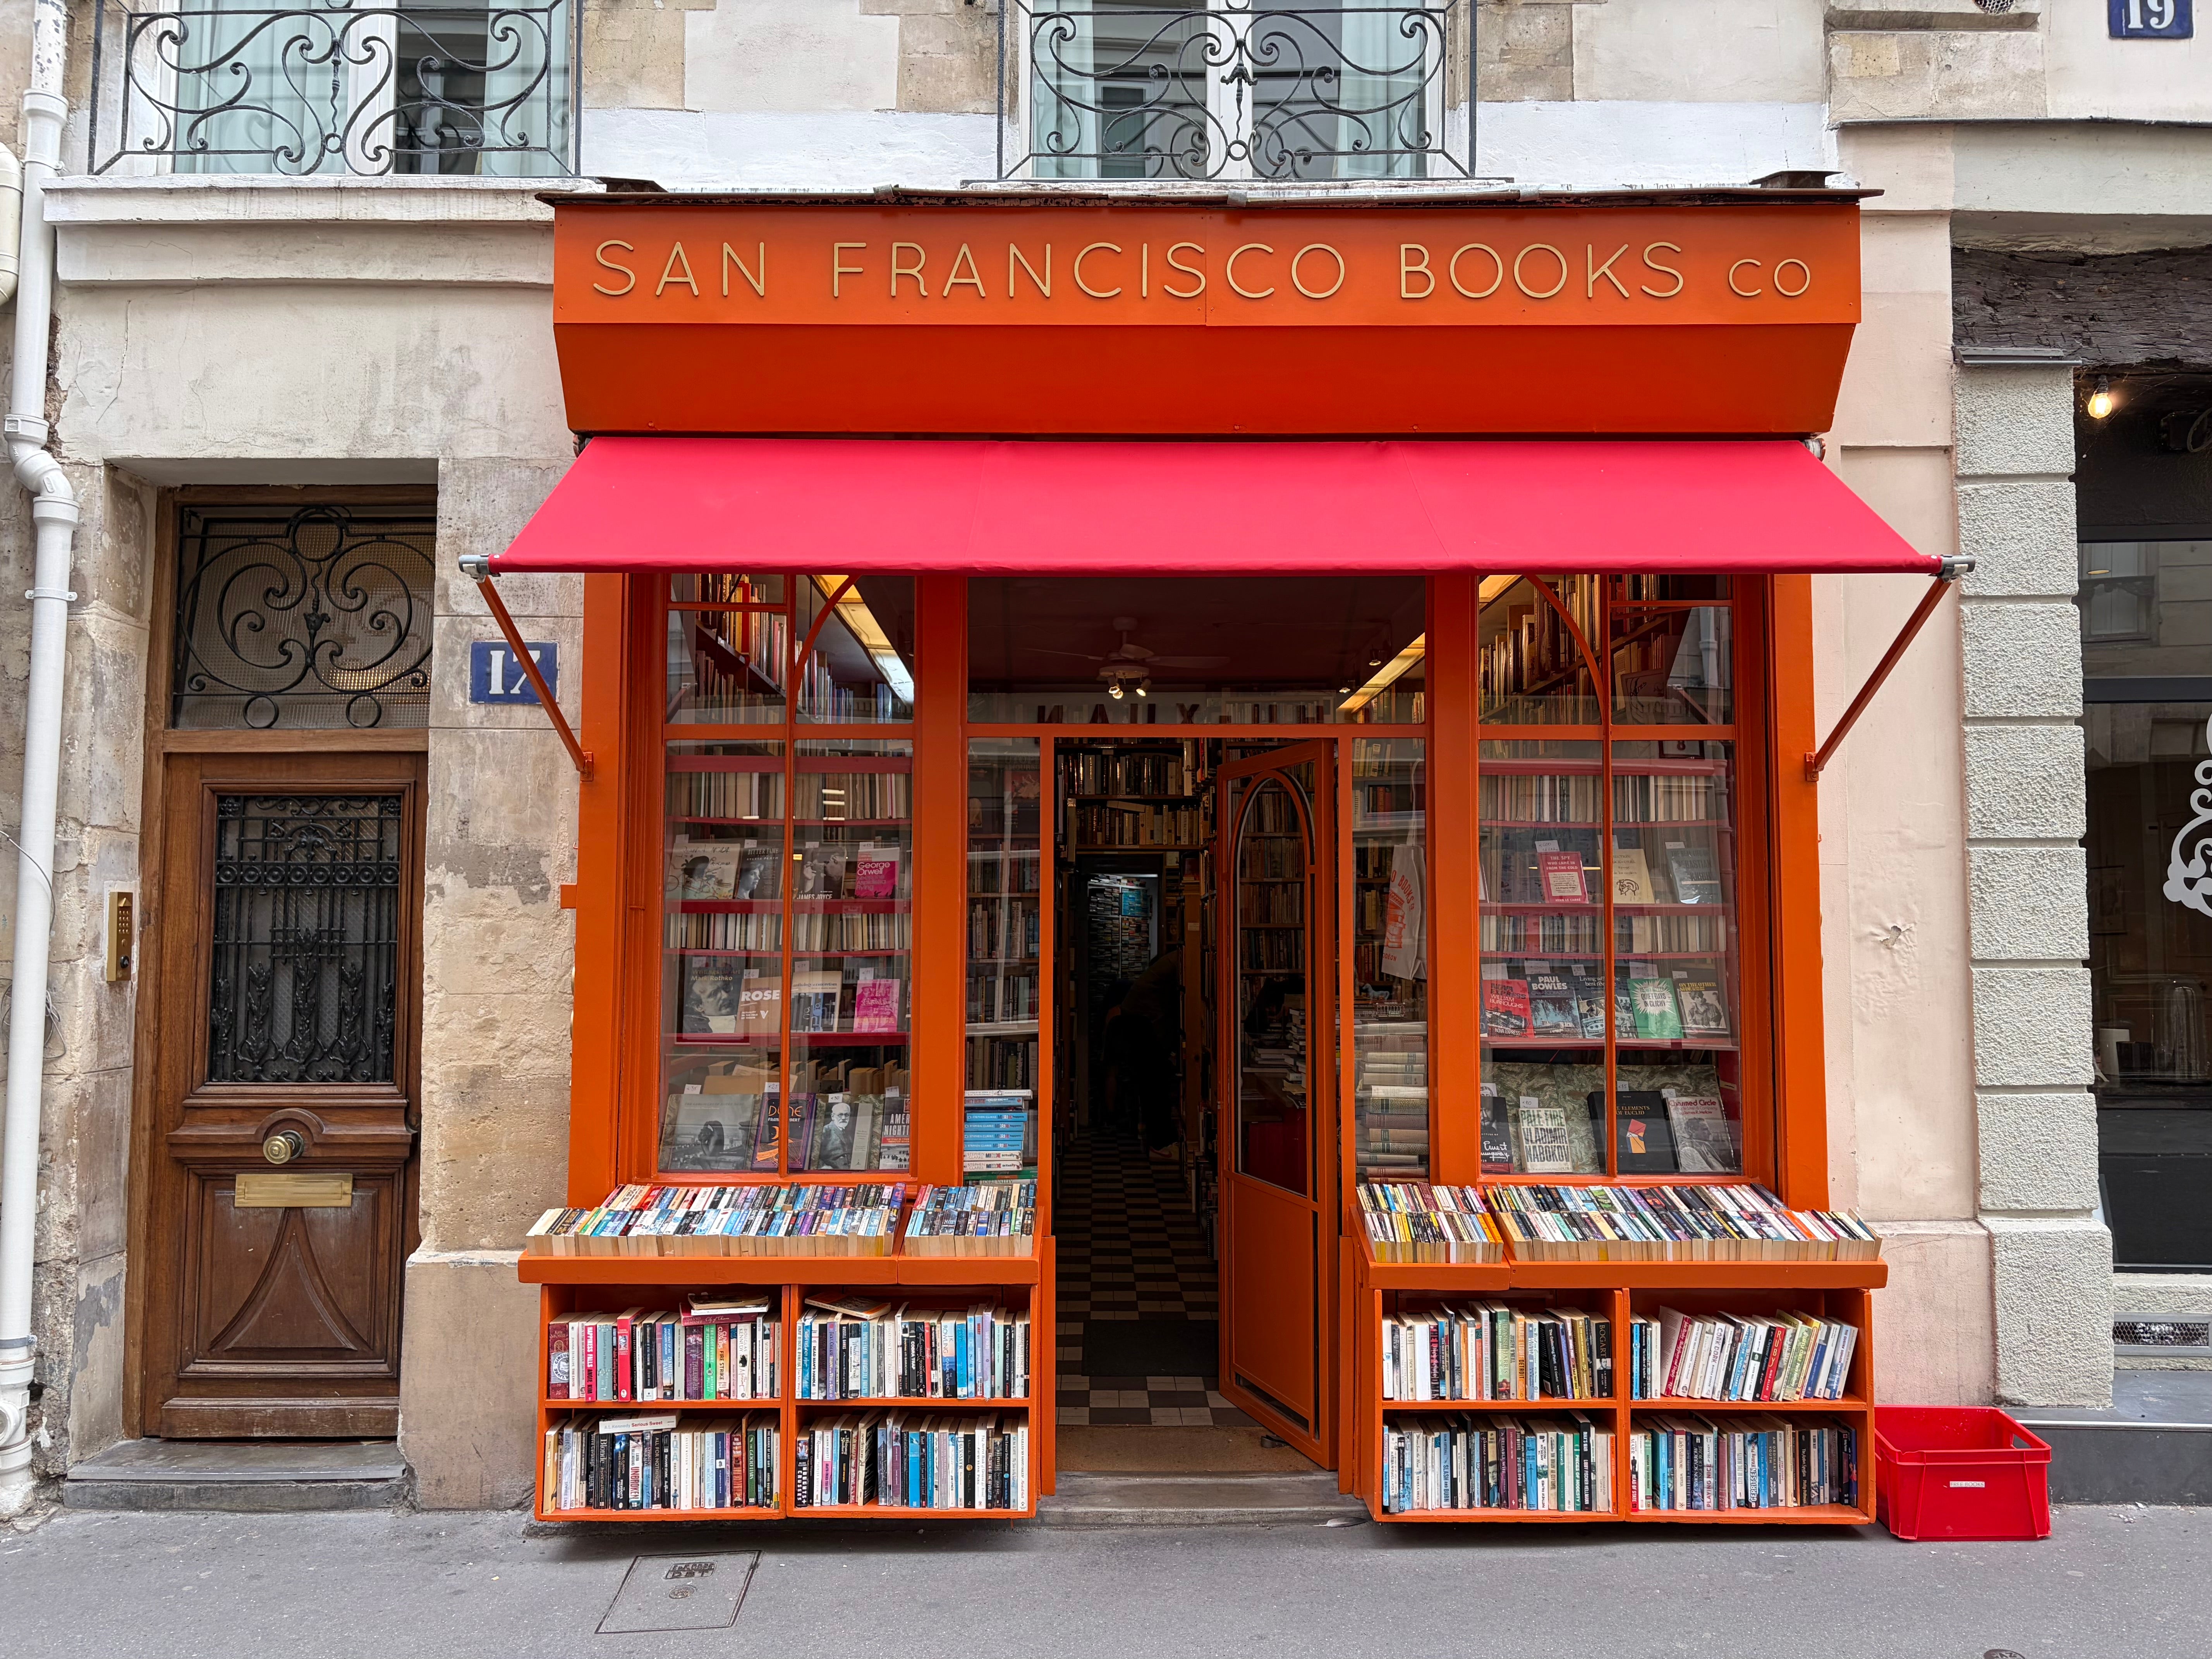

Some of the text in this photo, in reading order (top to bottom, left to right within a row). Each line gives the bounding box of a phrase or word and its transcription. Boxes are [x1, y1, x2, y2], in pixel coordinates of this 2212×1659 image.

[2128, 0, 2174, 29] 19
[592, 239, 1811, 299] SAN FRANCISCO BOOKS CO
[489, 650, 540, 694] 17
[1398, 875, 1414, 904] BOOKS
[741, 990, 780, 1001] ROSE
[1491, 983, 1513, 992] NOVA
[1491, 990, 1526, 999] EXPRESS
[1490, 999, 1523, 1008] BURROUGHS
[1491, 994, 1514, 1002] WILLIAM
[1520, 1110, 1565, 1126] PALE FIRE
[1523, 1128, 1568, 1144] VLADIMIR
[1525, 1145, 1569, 1162] NABOKOV
[1768, 1331, 1782, 1367] RUBY
[630, 1467, 639, 1499] UNBROKEN
